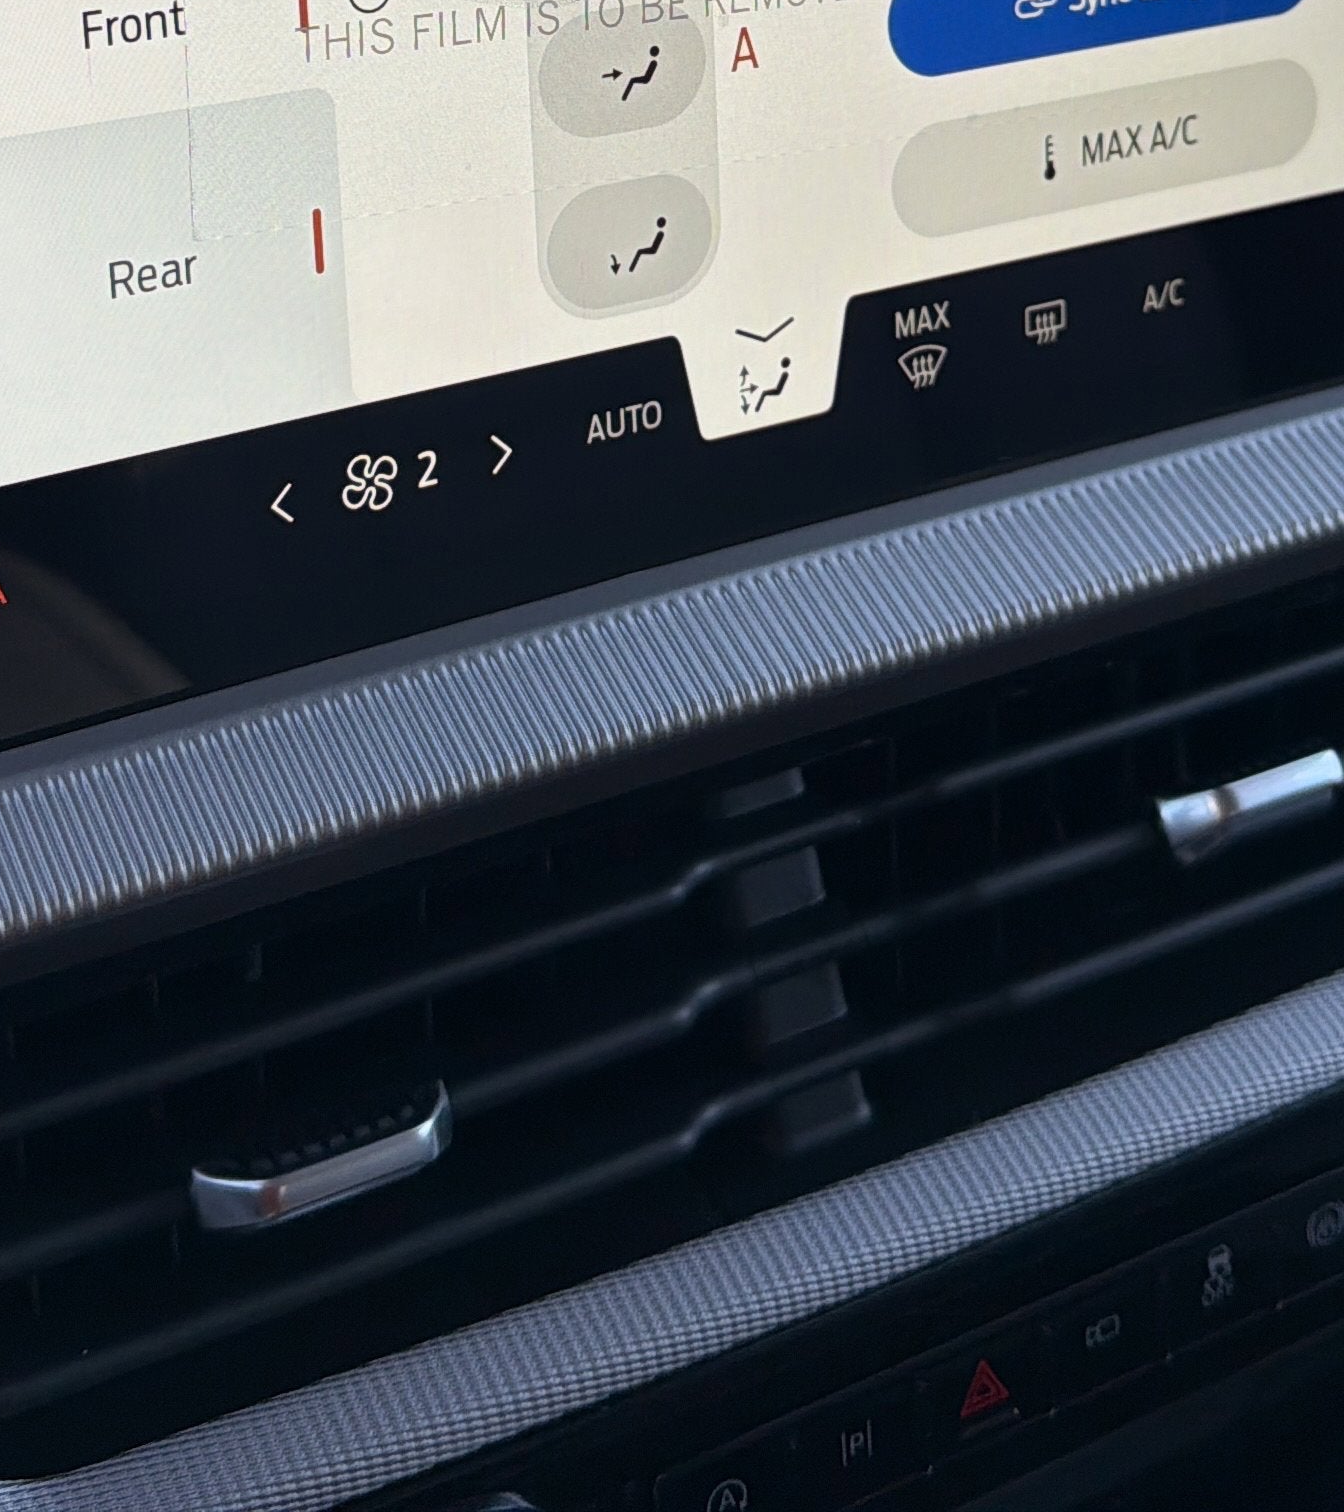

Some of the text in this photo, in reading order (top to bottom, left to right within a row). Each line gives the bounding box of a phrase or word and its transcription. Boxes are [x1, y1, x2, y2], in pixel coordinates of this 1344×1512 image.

[81, 0, 188, 50] Front
[295, 16, 395, 64] THIS
[412, 4, 507, 50] FILM
[524, 0, 560, 37] IS
[730, 25, 761, 73] A
[1081, 112, 1199, 168] MAX A/C
[108, 252, 198, 300] Rear
[1142, 278, 1186, 314] A/C
[894, 300, 952, 340] MAX
[585, 399, 663, 445] AUTO
[416, 449, 439, 489] 2
